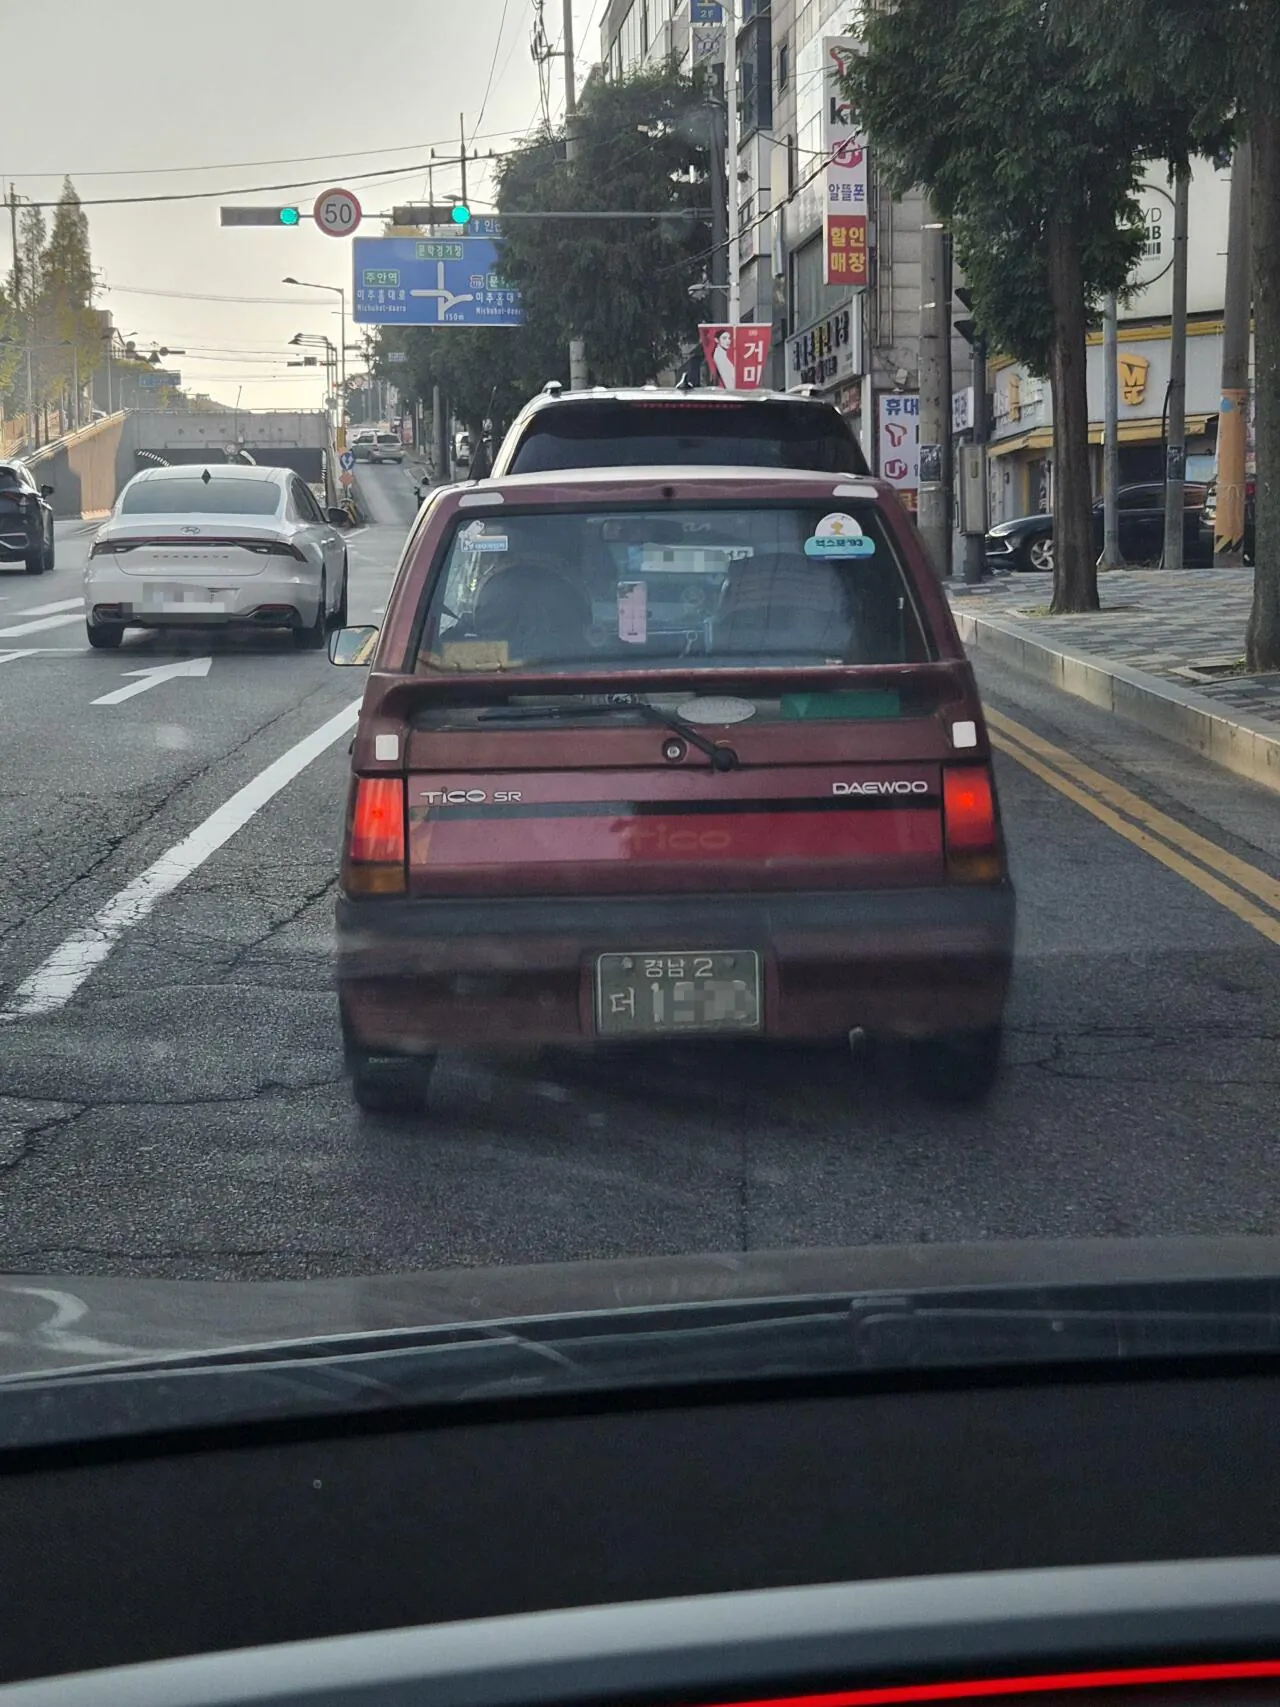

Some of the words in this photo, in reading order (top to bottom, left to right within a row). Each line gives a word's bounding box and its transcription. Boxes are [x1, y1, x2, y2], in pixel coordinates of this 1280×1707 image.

[828, 183, 865, 202] 알뜰폰
[325, 203, 352, 224] 50
[830, 227, 865, 249] 할인
[418, 244, 462, 258] 문학경기장
[830, 252, 866, 273] 매장
[366, 271, 398, 285] 주안역
[356, 289, 406, 303] 미추홀대로
[493, 790, 522, 802] SR
[832, 780, 929, 795] DAEWOO
[644, 958, 685, 978] 경남
[693, 957, 713, 977] 2
